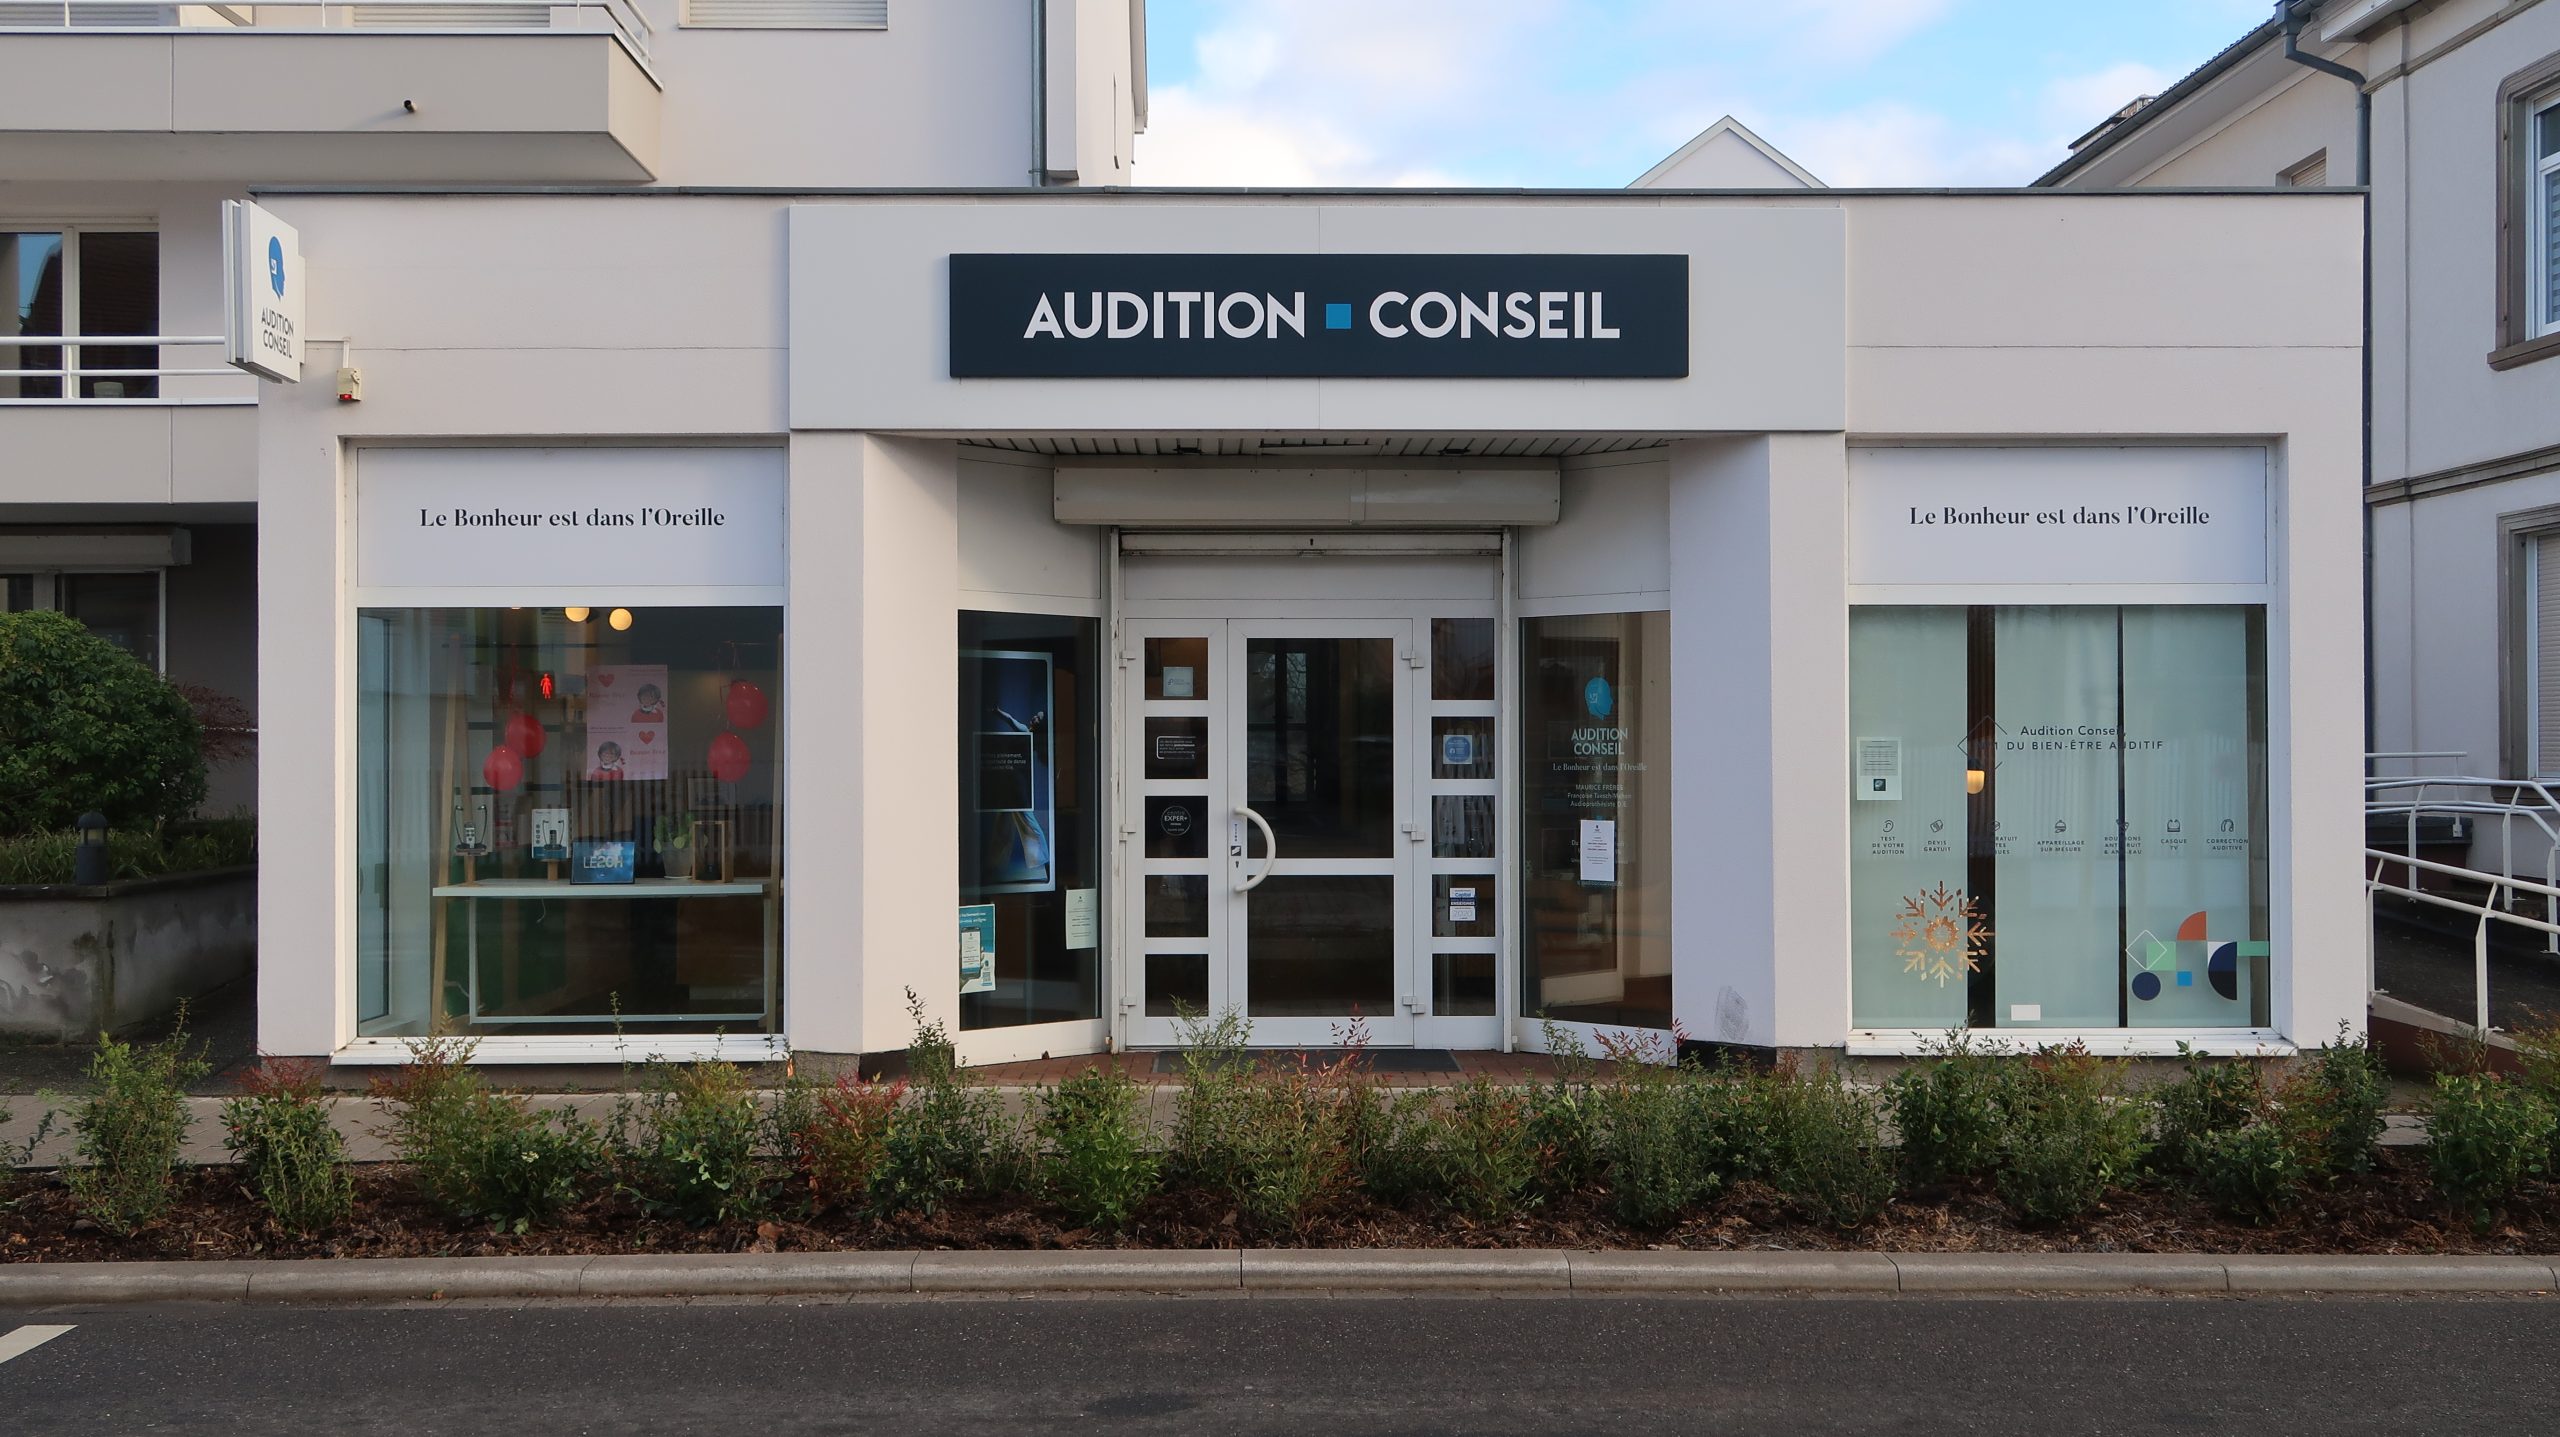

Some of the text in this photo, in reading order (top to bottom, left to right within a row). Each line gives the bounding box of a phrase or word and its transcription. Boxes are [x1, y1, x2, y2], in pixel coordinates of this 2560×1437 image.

[261, 307, 294, 337] AUDITION
[1023, 290, 1620, 340] AUDITION CONSEIL
[263, 329, 292, 359] CONSEIL
[420, 507, 725, 527] Le Bonheur est dans l'Oreille
[1910, 506, 2210, 525] Le Bonheur est dans l'Oreille
[1571, 727, 1629, 741] AUDITION
[2020, 725, 2074, 736] Audition
[1573, 742, 1625, 755] CONSEIL
[2007, 741, 2025, 750] DU
[1552, 763, 1561, 771] Le
[1563, 762, 1590, 771] Bonheur
